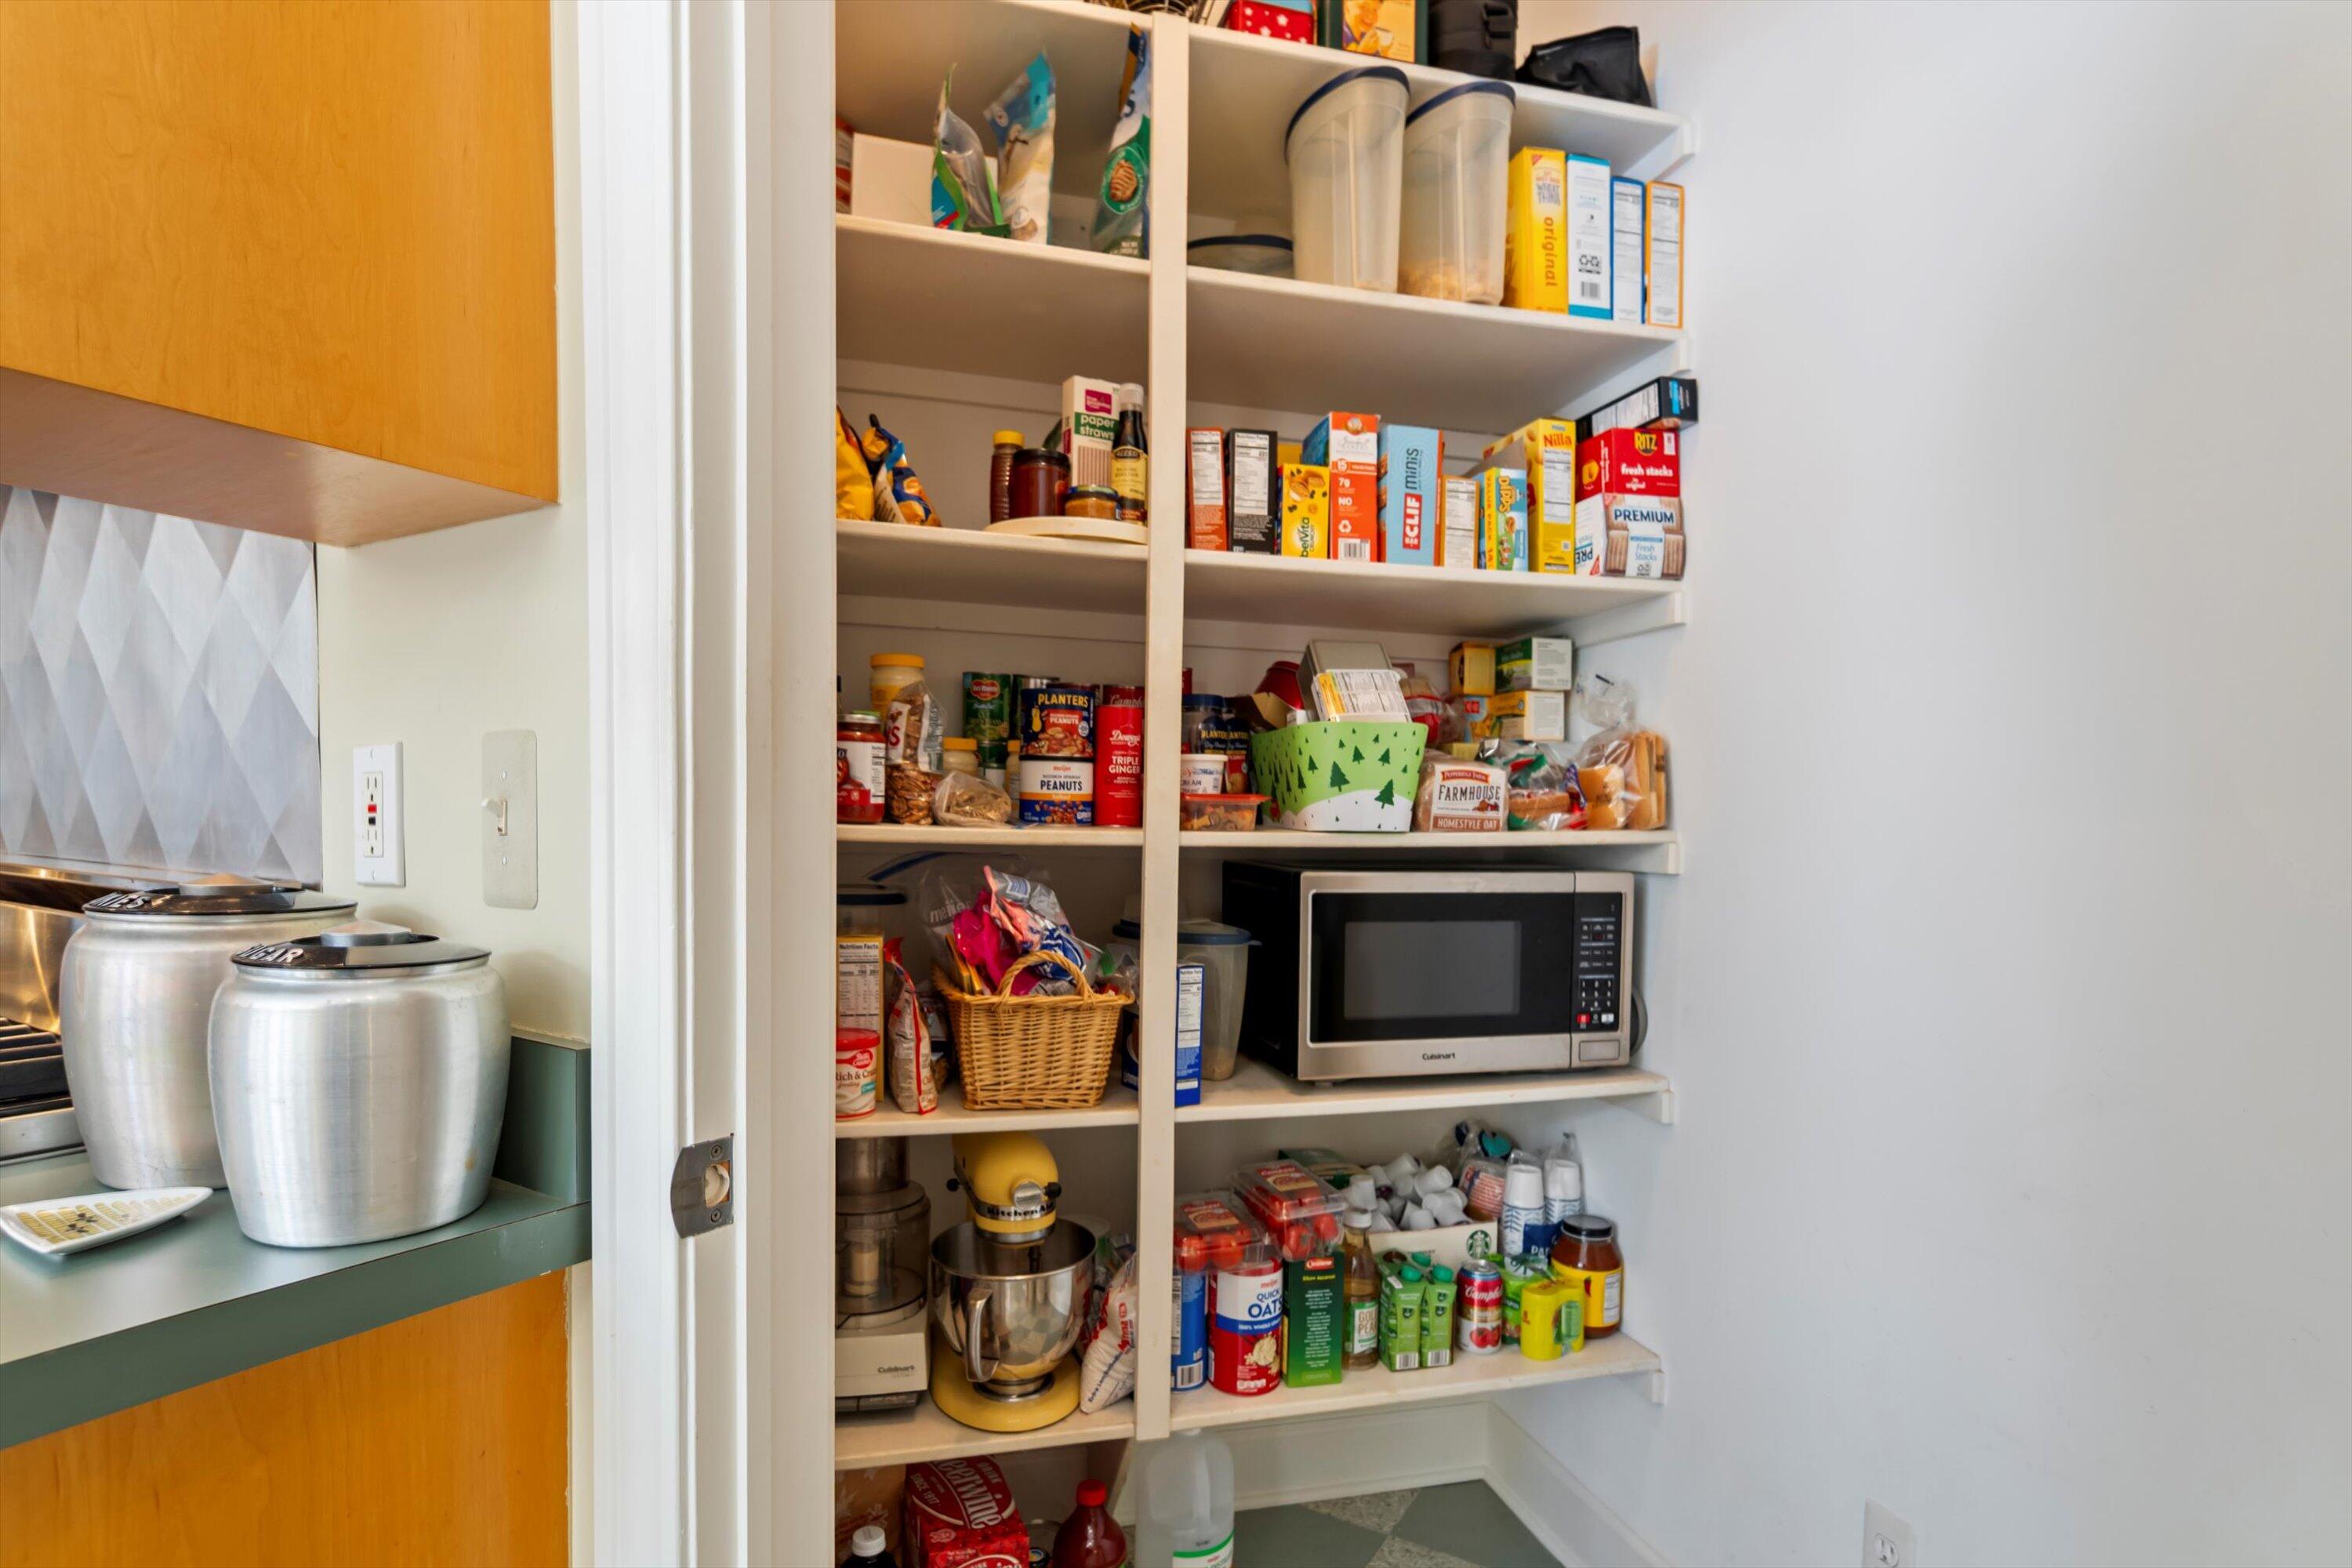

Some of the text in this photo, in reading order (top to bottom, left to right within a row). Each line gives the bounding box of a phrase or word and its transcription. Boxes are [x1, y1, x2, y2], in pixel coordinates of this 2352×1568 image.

[1542, 216, 1558, 288] original
[1080, 415, 1115, 429] paper
[1544, 433, 1572, 447] Nilla
[1635, 432, 1657, 450] RITZ
[1621, 463, 1674, 477] fresh stacks
[1406, 448, 1420, 536] CLIF minis
[1338, 496, 1353, 506] NO
[1613, 508, 1675, 524] PREMIUM
[1037, 692, 1089, 709] PLANTERS
[1050, 717, 1080, 725] PEANUTS
[1111, 756, 1139, 766] TRIPLE
[1109, 765, 1141, 775] GINGER
[1040, 779, 1083, 791] PEANUTS
[1438, 784, 1501, 801] FARMHOUSE
[1437, 818, 1497, 829] HOMESTYLE OAT
[1257, 1287, 1279, 1302] QUICK
[1247, 1294, 1283, 1319] OATS
[909, 1472, 940, 1504] SINCE 1917
